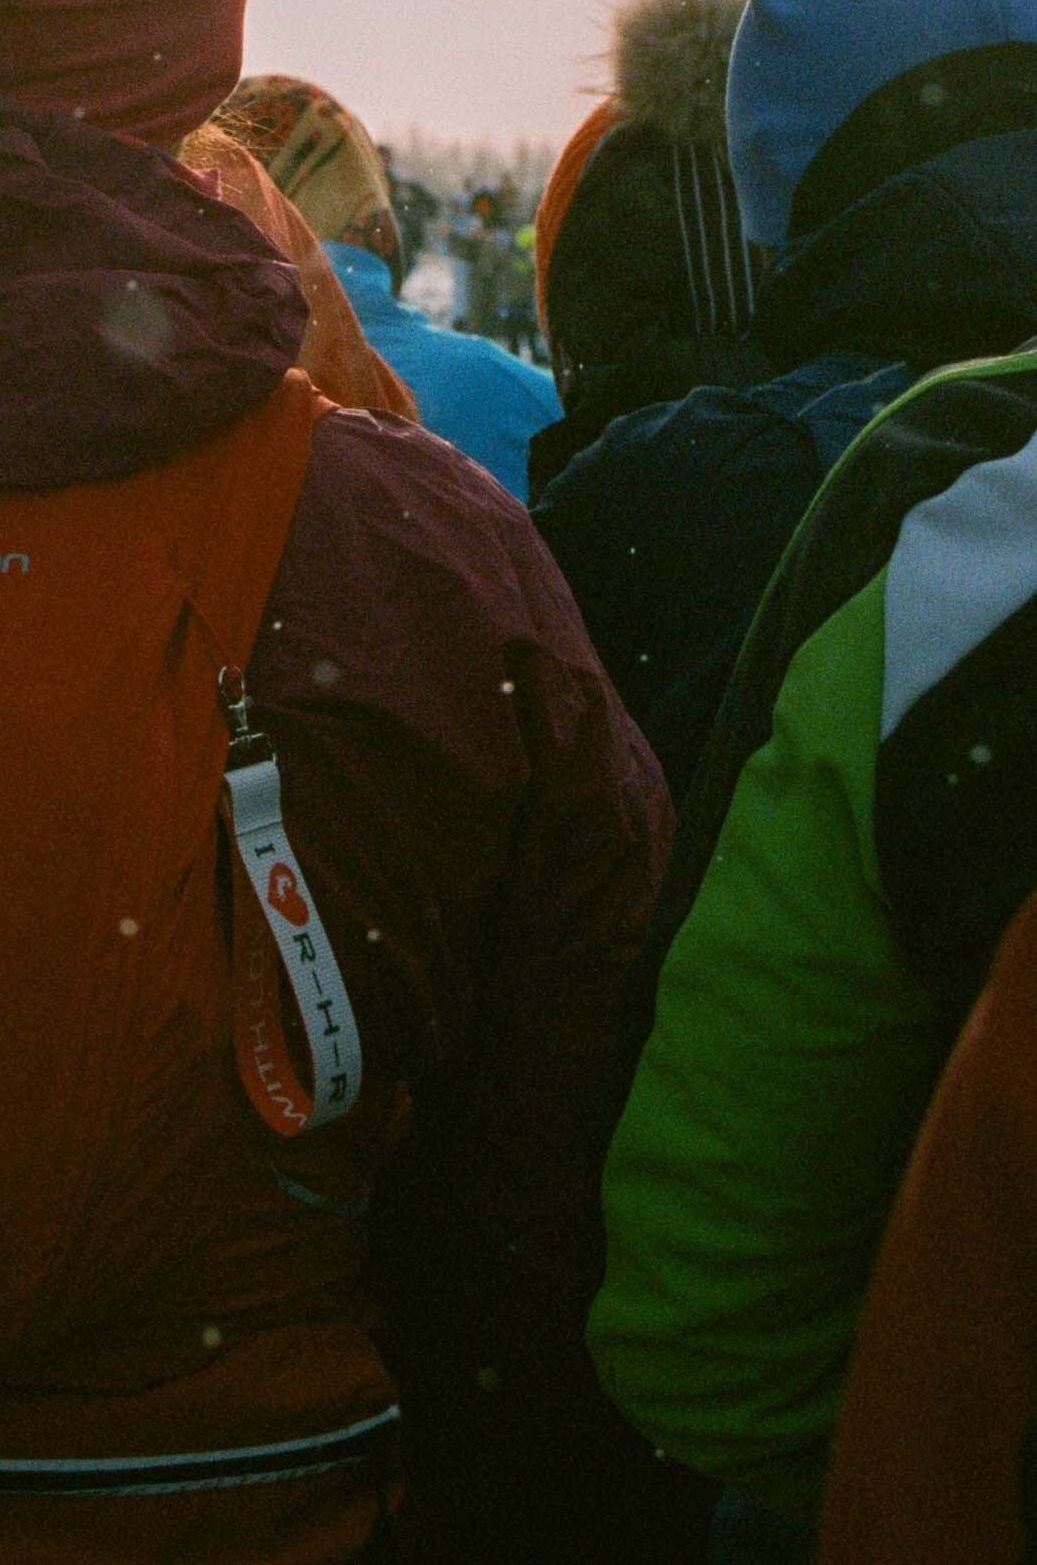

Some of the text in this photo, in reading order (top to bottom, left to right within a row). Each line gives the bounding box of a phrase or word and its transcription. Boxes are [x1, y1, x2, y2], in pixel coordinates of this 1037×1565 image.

[254, 841, 349, 1108] I R-H-R
[249, 1021, 309, 1129] WITH
